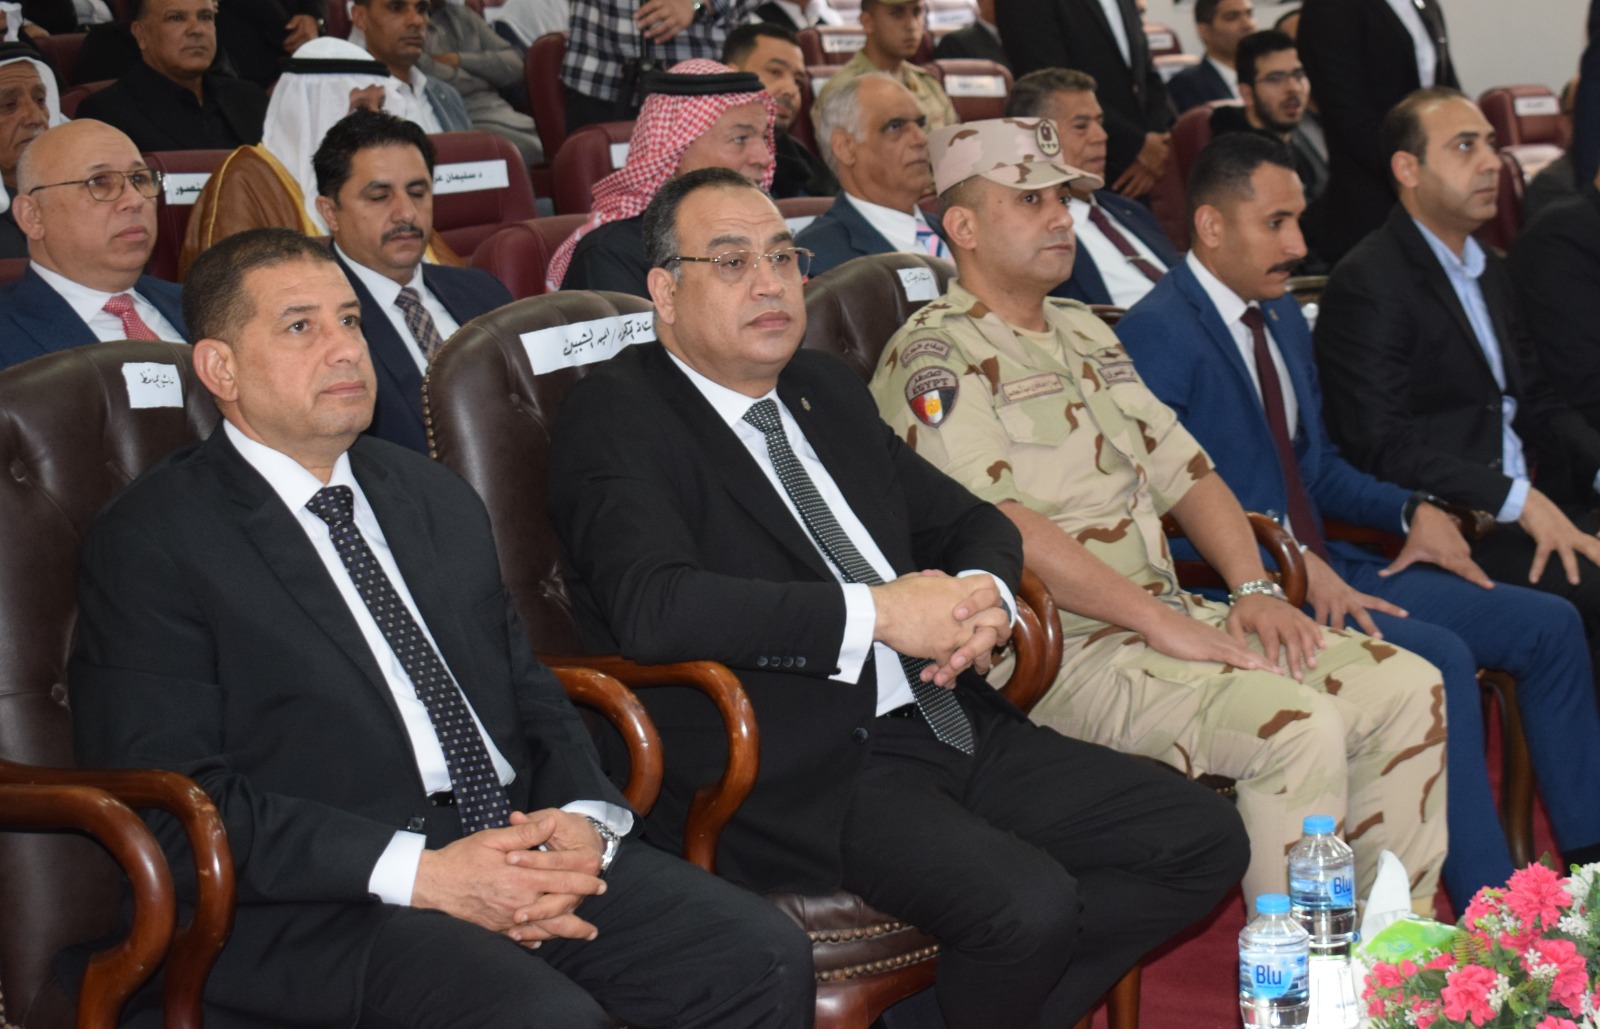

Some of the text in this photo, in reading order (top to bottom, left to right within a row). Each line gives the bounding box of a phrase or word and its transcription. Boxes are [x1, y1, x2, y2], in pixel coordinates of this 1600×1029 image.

[912, 377, 949, 395] EGYPT
[1333, 875, 1352, 895] Blu
[1256, 964, 1282, 985] Blu
